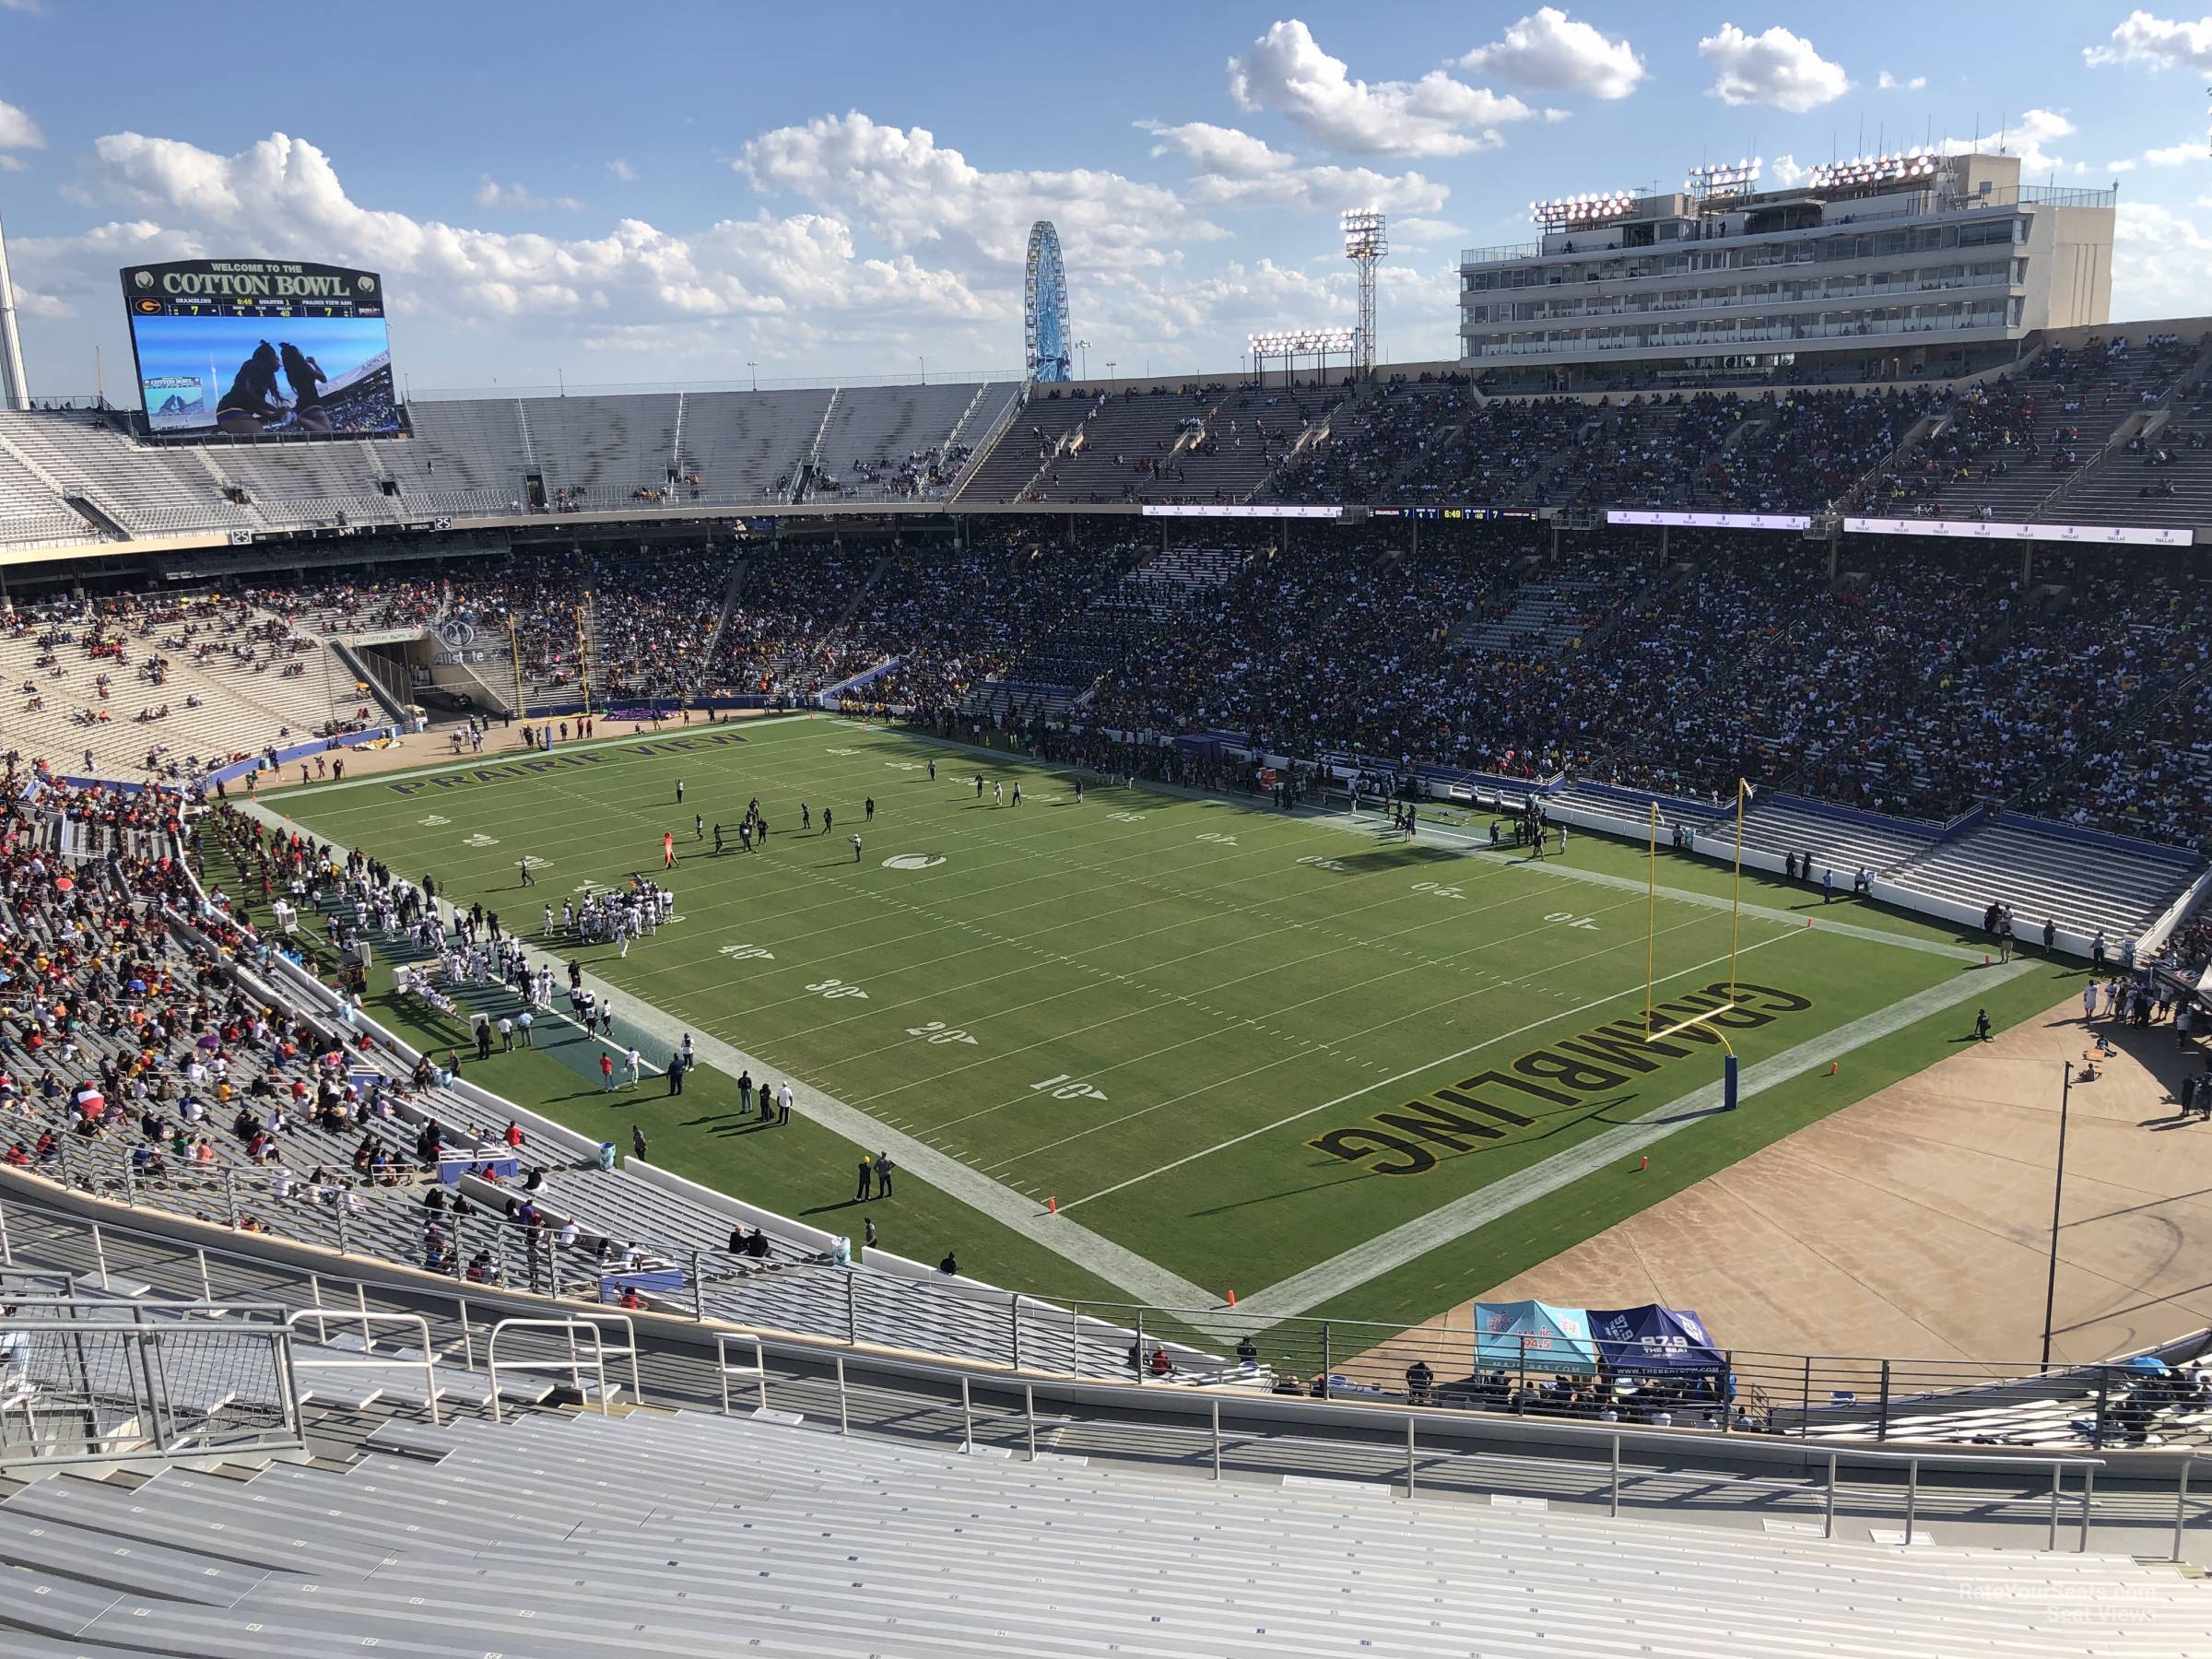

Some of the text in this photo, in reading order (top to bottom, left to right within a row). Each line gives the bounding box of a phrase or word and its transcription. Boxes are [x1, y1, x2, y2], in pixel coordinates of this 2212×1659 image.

[211, 263, 264, 272] WELCOME
[282, 265, 302, 273] THE
[163, 273, 350, 297] COTTON BOWL
[191, 306, 198, 315] 7
[324, 307, 332, 316] 7
[1404, 509, 1409, 517] 7
[1444, 510, 1461, 518] 6:49
[1493, 511, 1499, 519] 7
[437, 518, 450, 528] 25
[235, 531, 249, 543] 25
[435, 651, 485, 665] Allstate
[388, 733, 750, 796] PRAIRIE VIEW
[1411, 882, 1465, 897] 20
[1543, 912, 1597, 927] 10
[717, 944, 768, 959] 40
[805, 979, 860, 999] 30
[905, 1021, 967, 1044] 20
[1304, 982, 1815, 1176] GRAMBLING
[1030, 1074, 1093, 1100] 10
[1524, 1338, 1551, 1349] 94.5
[1641, 1335, 1688, 1347] 97.9
